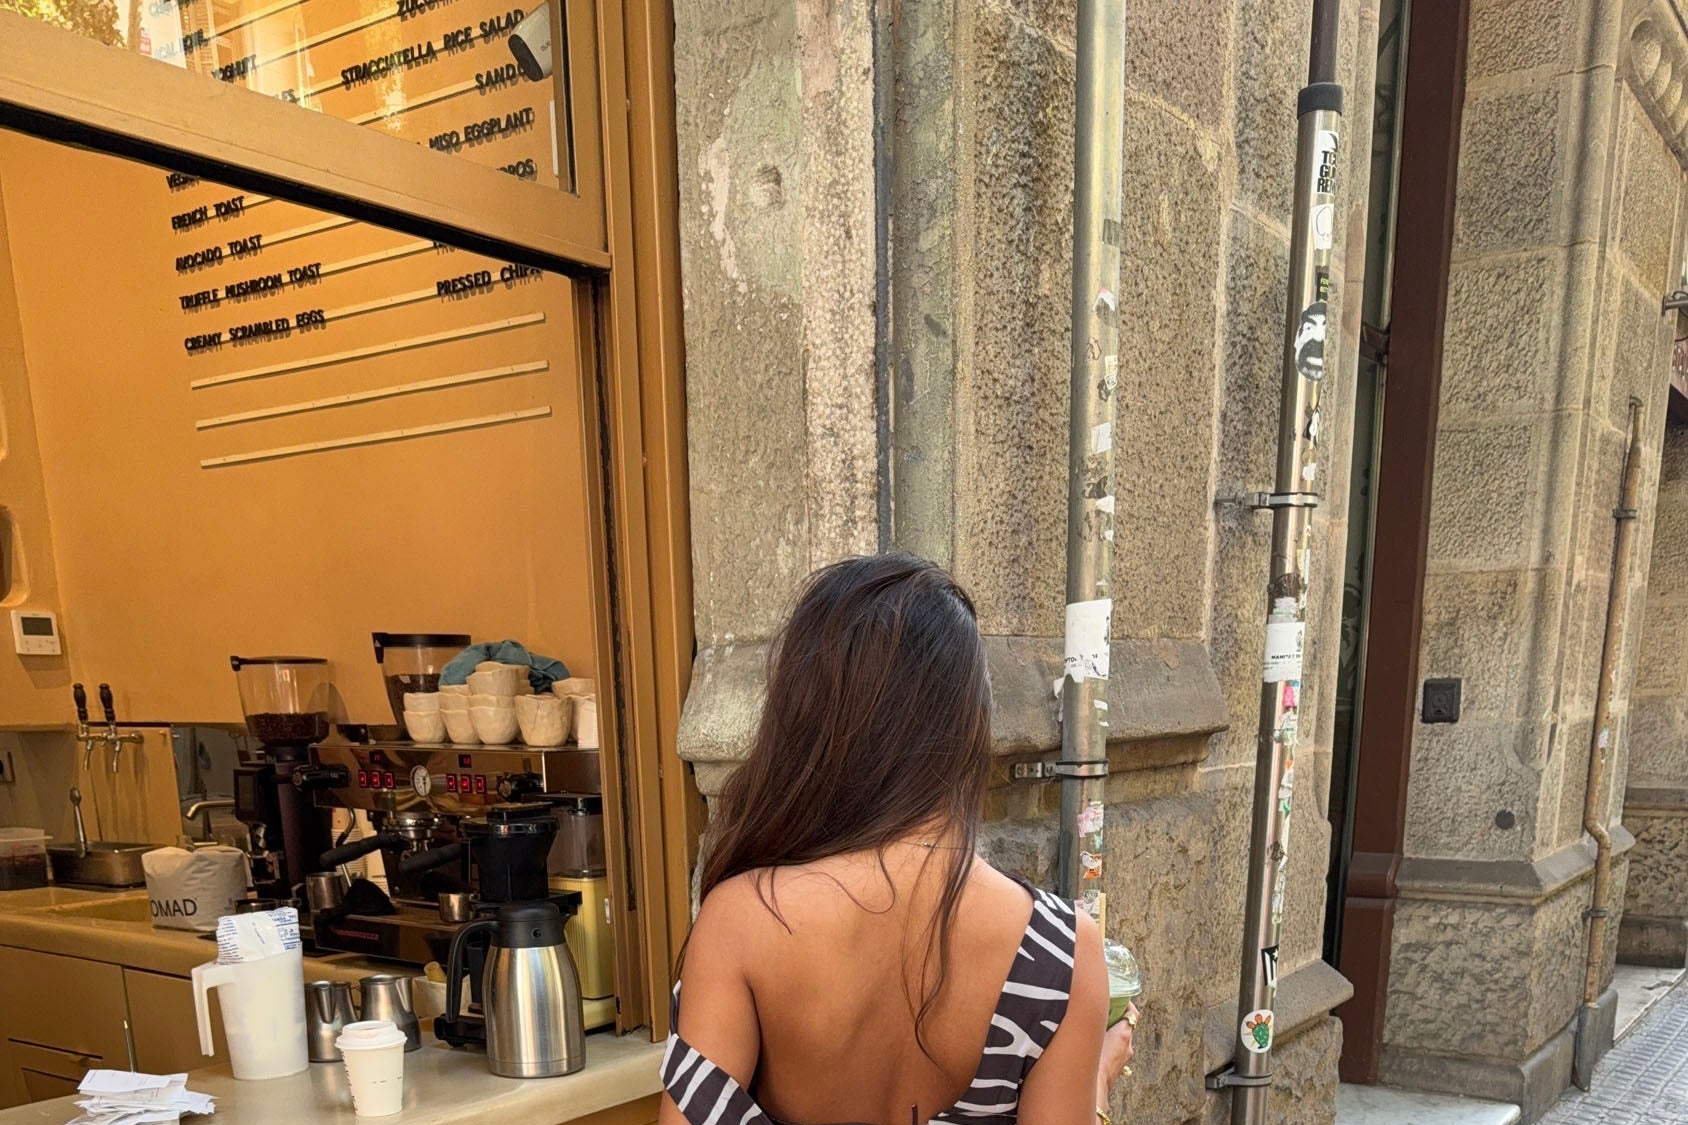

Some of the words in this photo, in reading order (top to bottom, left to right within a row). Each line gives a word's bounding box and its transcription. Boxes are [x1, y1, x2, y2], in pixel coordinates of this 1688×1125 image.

[341, 41, 437, 85] STRACCIATELLA
[443, 26, 473, 49] RICE
[479, 9, 526, 38] SALAD
[464, 107, 533, 142] EGGPLANT
[171, 206, 208, 230] FRENCH
[214, 196, 245, 216] TOAST
[175, 246, 223, 271] AVOCADO
[227, 234, 262, 255] TOAST
[179, 288, 219, 309] TRUFFLE
[225, 273, 283, 298] MUSHROOM
[287, 262, 321, 283] TOAST
[436, 270, 492, 297] PRESSED
[184, 332, 222, 351] CREAMY
[229, 318, 290, 341] SCRAMBLED
[296, 309, 325, 328] EGGS
[150, 898, 197, 917] OMAD
